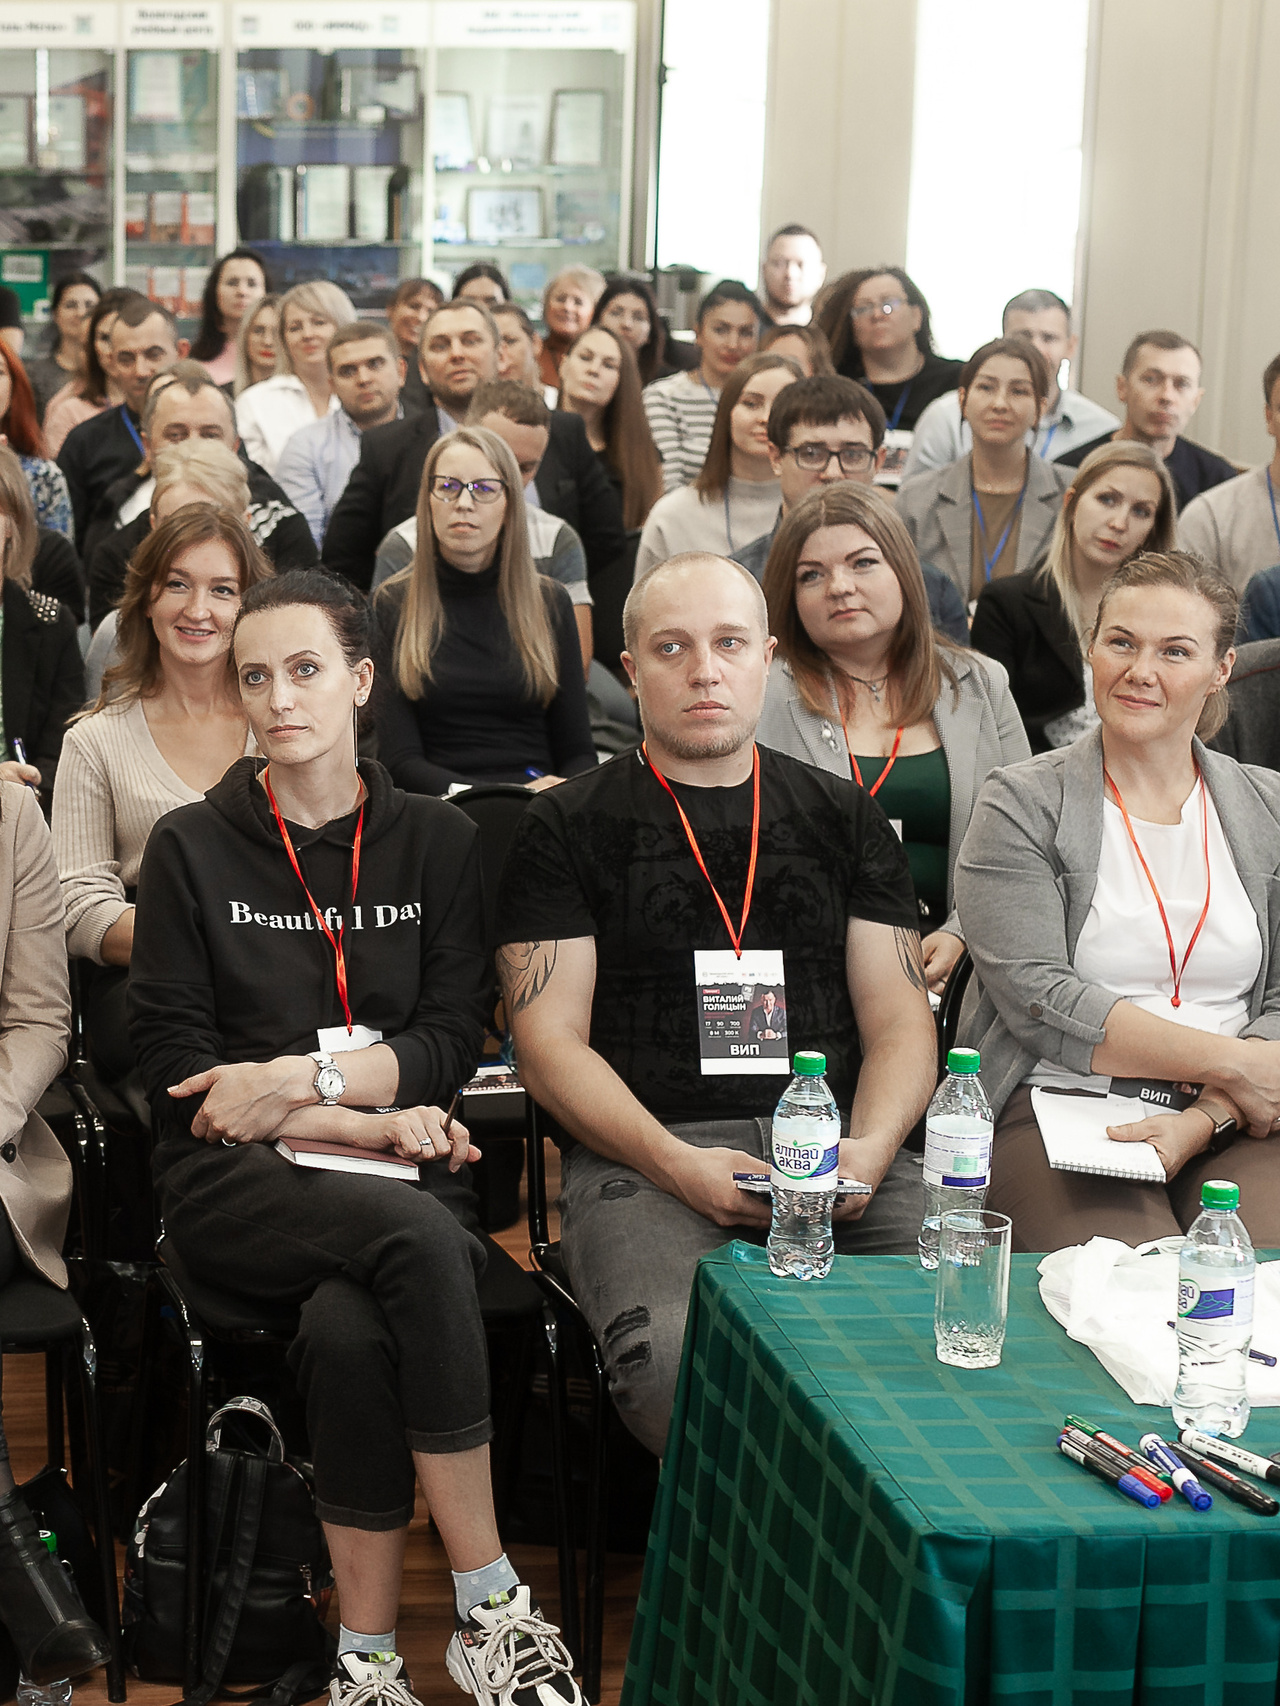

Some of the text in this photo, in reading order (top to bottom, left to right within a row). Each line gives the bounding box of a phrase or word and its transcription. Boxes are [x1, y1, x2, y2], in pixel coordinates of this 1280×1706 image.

[702, 994, 744, 1003] ВИТАЛИЙ
[703, 1003, 747, 1012] ГОЛИЦЫН
[730, 1044, 760, 1056] ВИП
[1140, 1088, 1171, 1105] ВИП
[775, 1143, 819, 1160] алтай
[778, 1156, 811, 1171] аква
